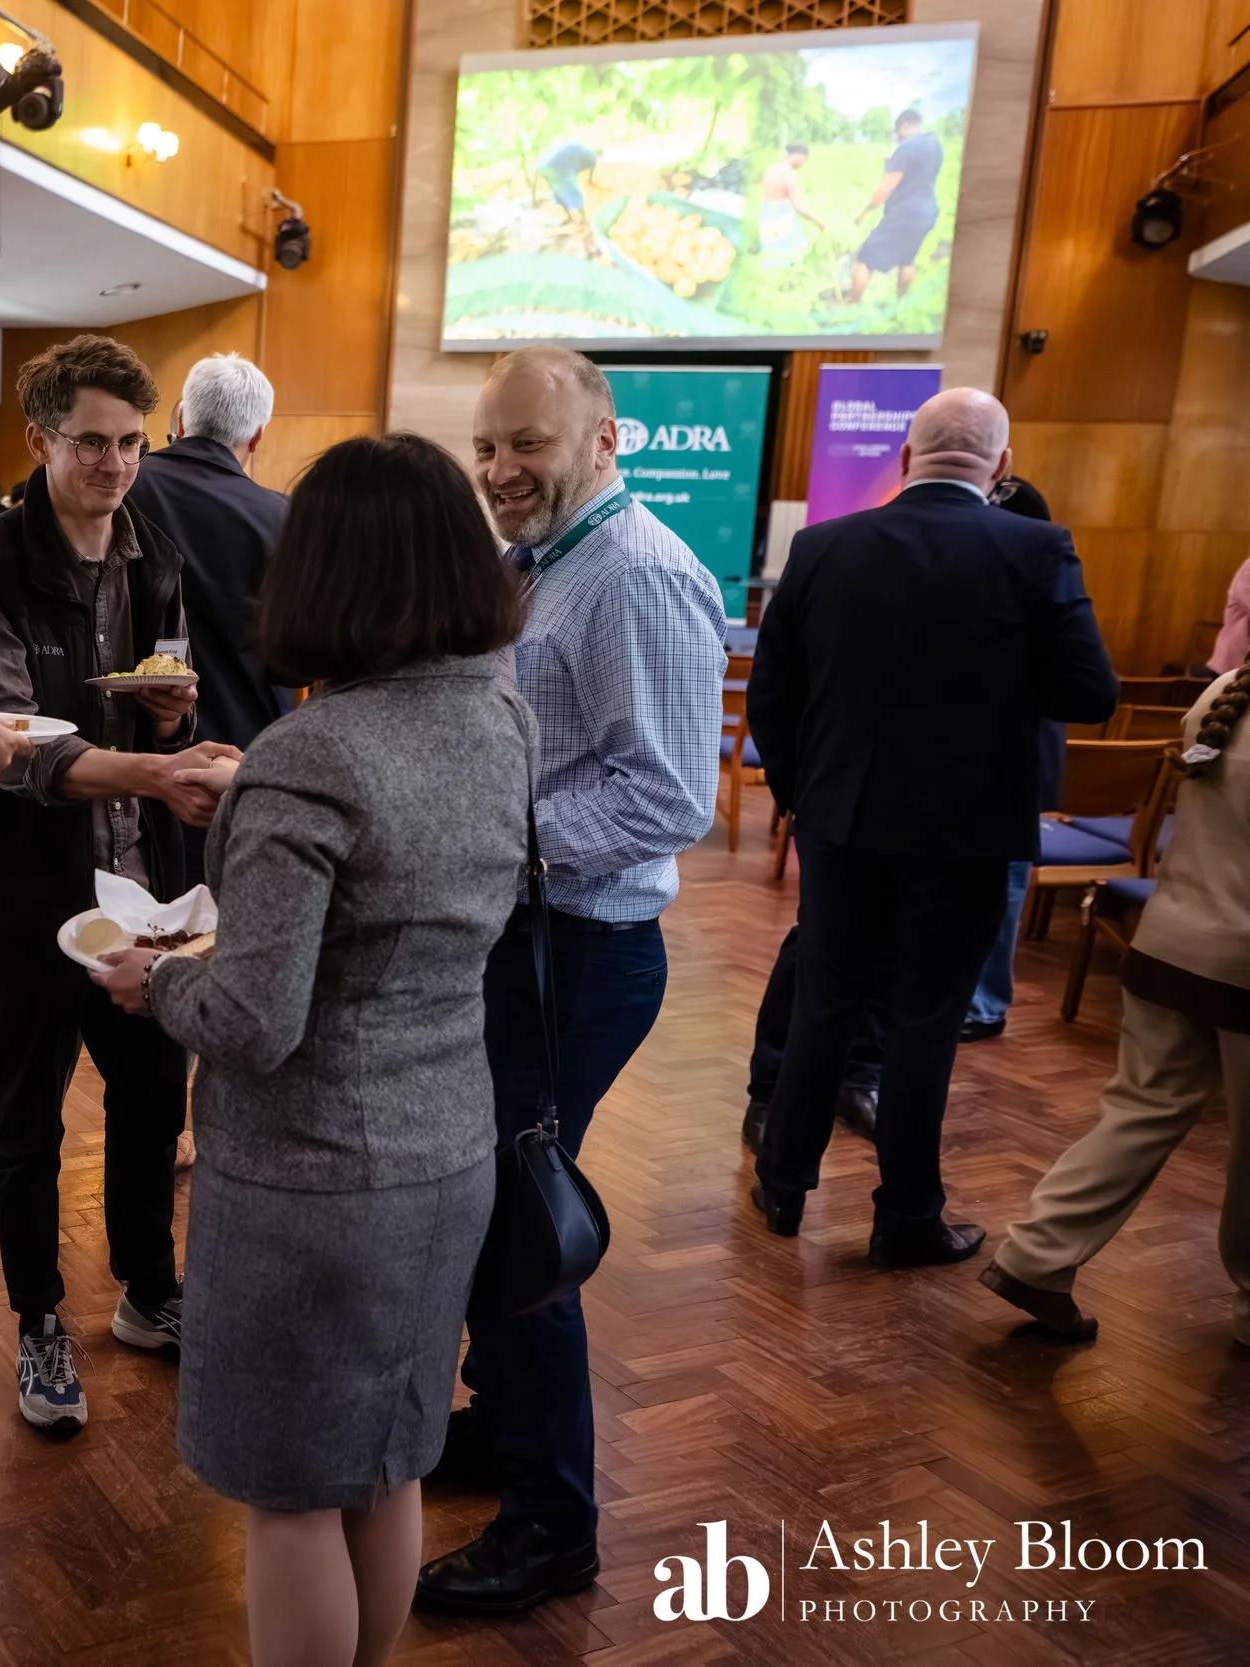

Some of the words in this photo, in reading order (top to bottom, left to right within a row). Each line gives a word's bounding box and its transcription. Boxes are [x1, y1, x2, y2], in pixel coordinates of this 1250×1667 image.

[831, 400, 875, 412] GLOBAL
[829, 421, 906, 433] CONFERENCE
[649, 424, 731, 452] ADRA
[600, 501, 621, 517] ADRA
[541, 548, 563, 568] ADRA
[40, 645, 65, 657] ADRA
